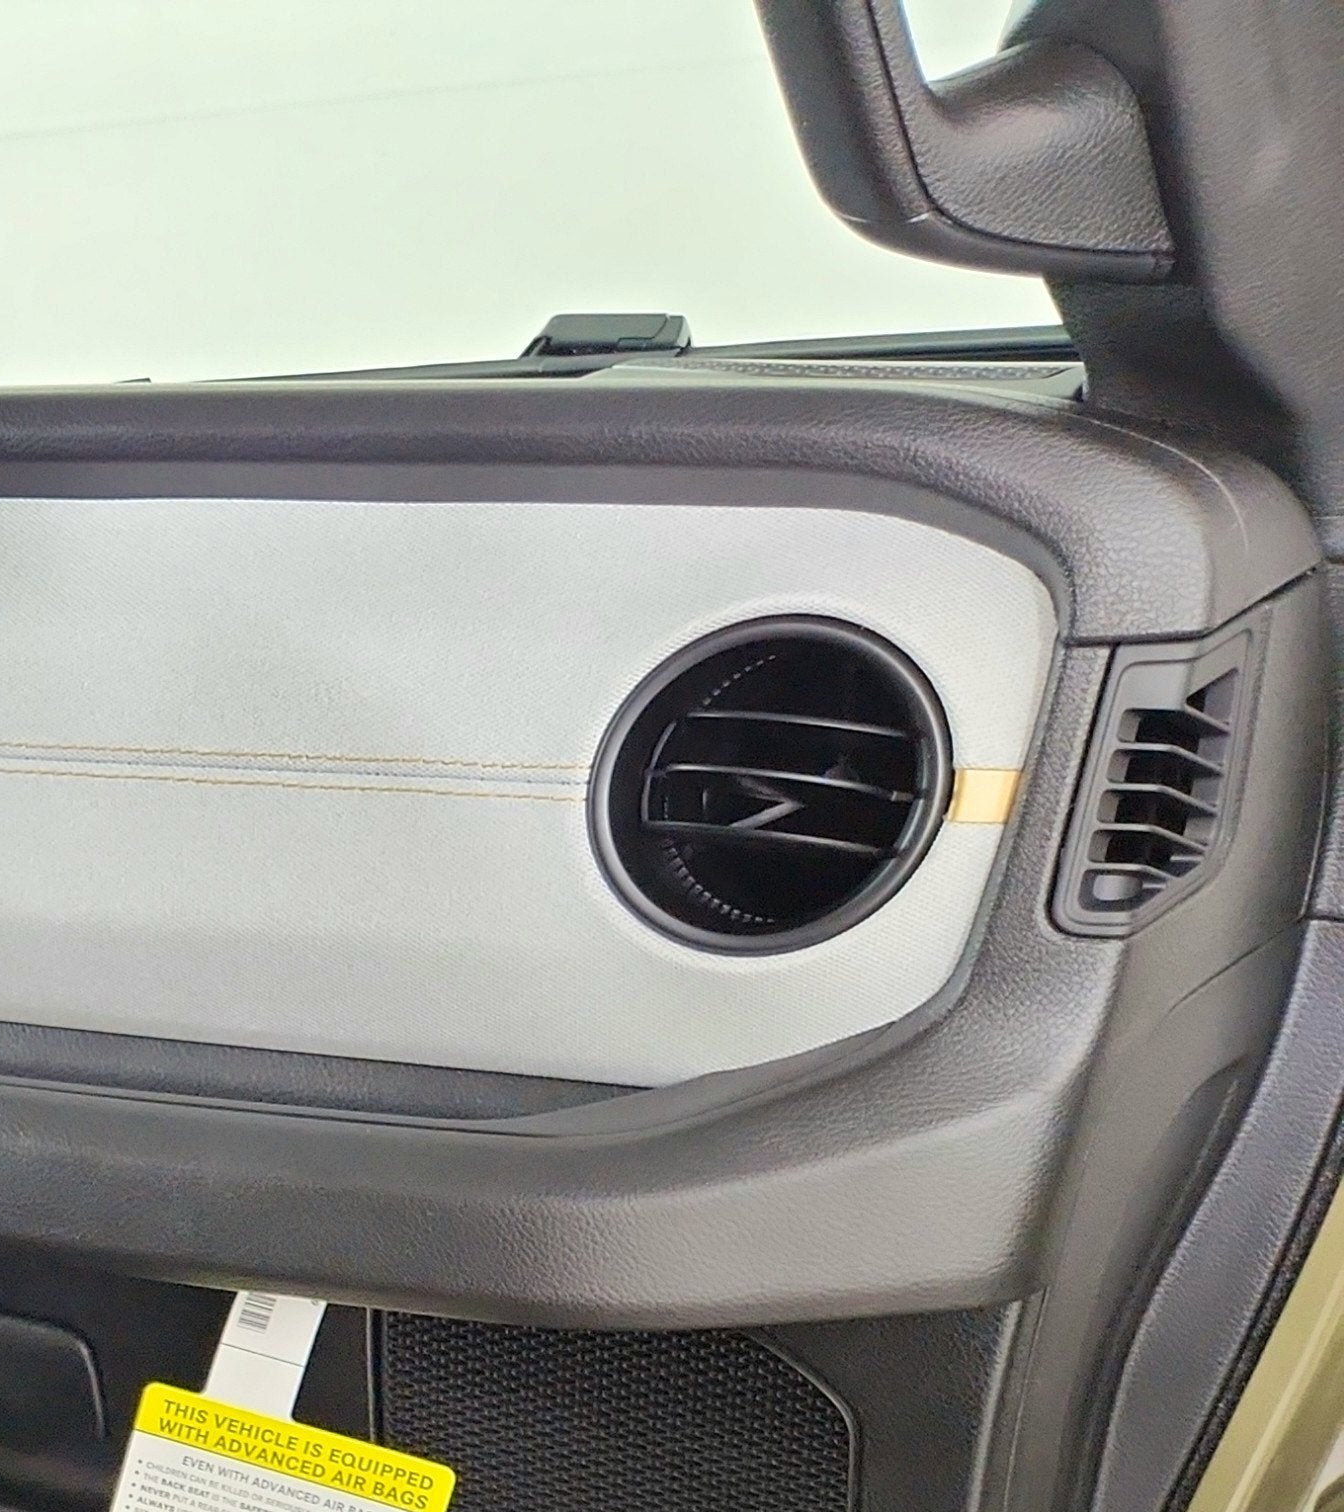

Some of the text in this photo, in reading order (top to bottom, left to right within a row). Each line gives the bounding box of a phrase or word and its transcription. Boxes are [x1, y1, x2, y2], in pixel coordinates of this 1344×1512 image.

[156, 1417, 428, 1510] WITH ADVANCED AIR BAGS
[161, 1399, 434, 1491] THIS VEHICLE IS EQUIPPED
[136, 1495, 175, 1512] ALWAYS
[181, 1455, 215, 1474] EVEN
[217, 1466, 249, 1484] WITH
[250, 1476, 321, 1505] ADVANCED
[322, 1498, 345, 1512] AIR
